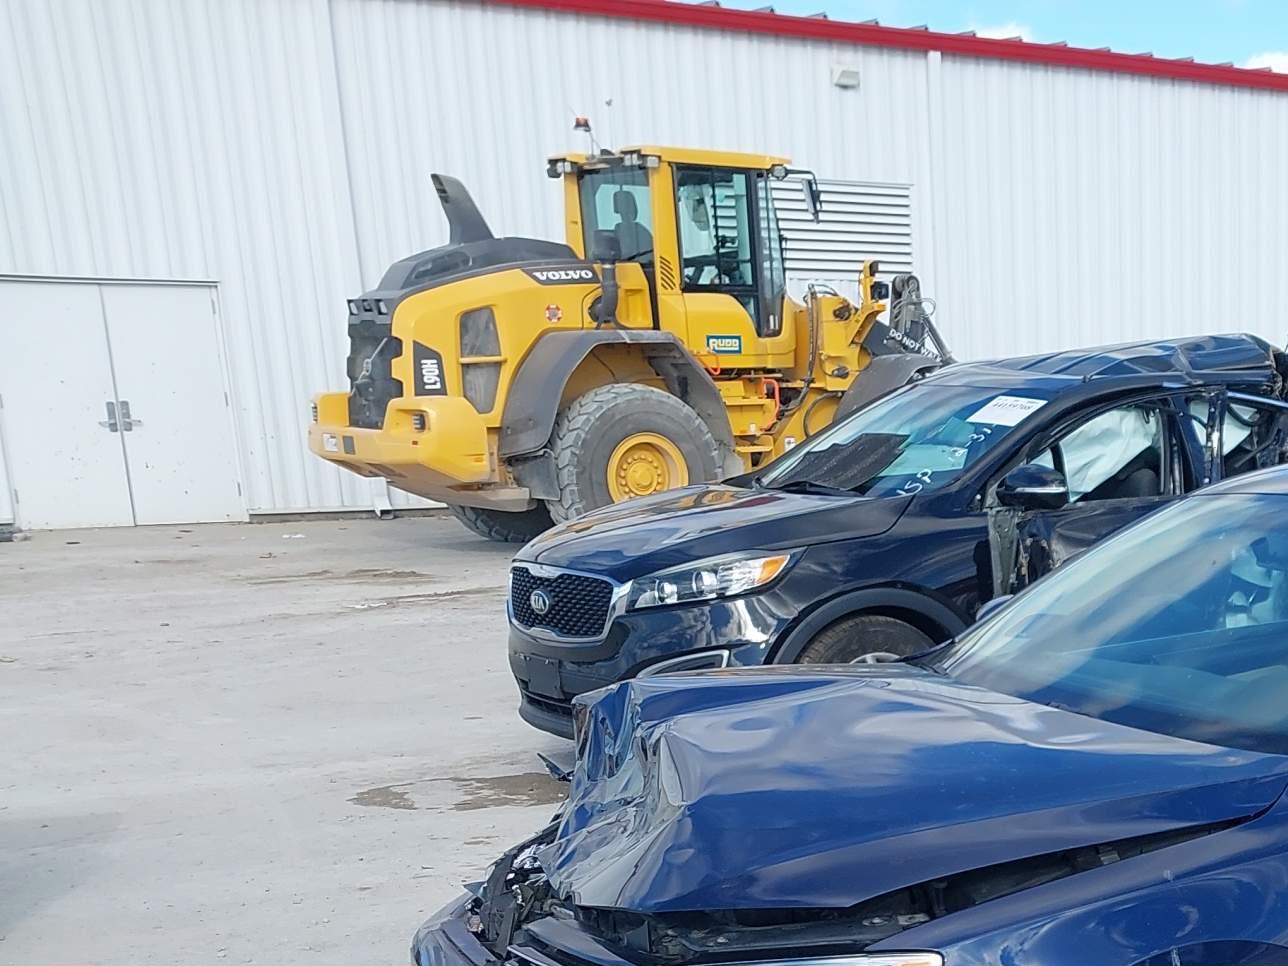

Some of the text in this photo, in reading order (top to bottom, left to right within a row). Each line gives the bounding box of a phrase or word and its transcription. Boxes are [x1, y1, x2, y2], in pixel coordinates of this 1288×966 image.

[532, 269, 593, 281] VOLVO
[889, 328, 903, 341] DO
[902, 336, 921, 351] NOT
[420, 359, 442, 390] L90H
